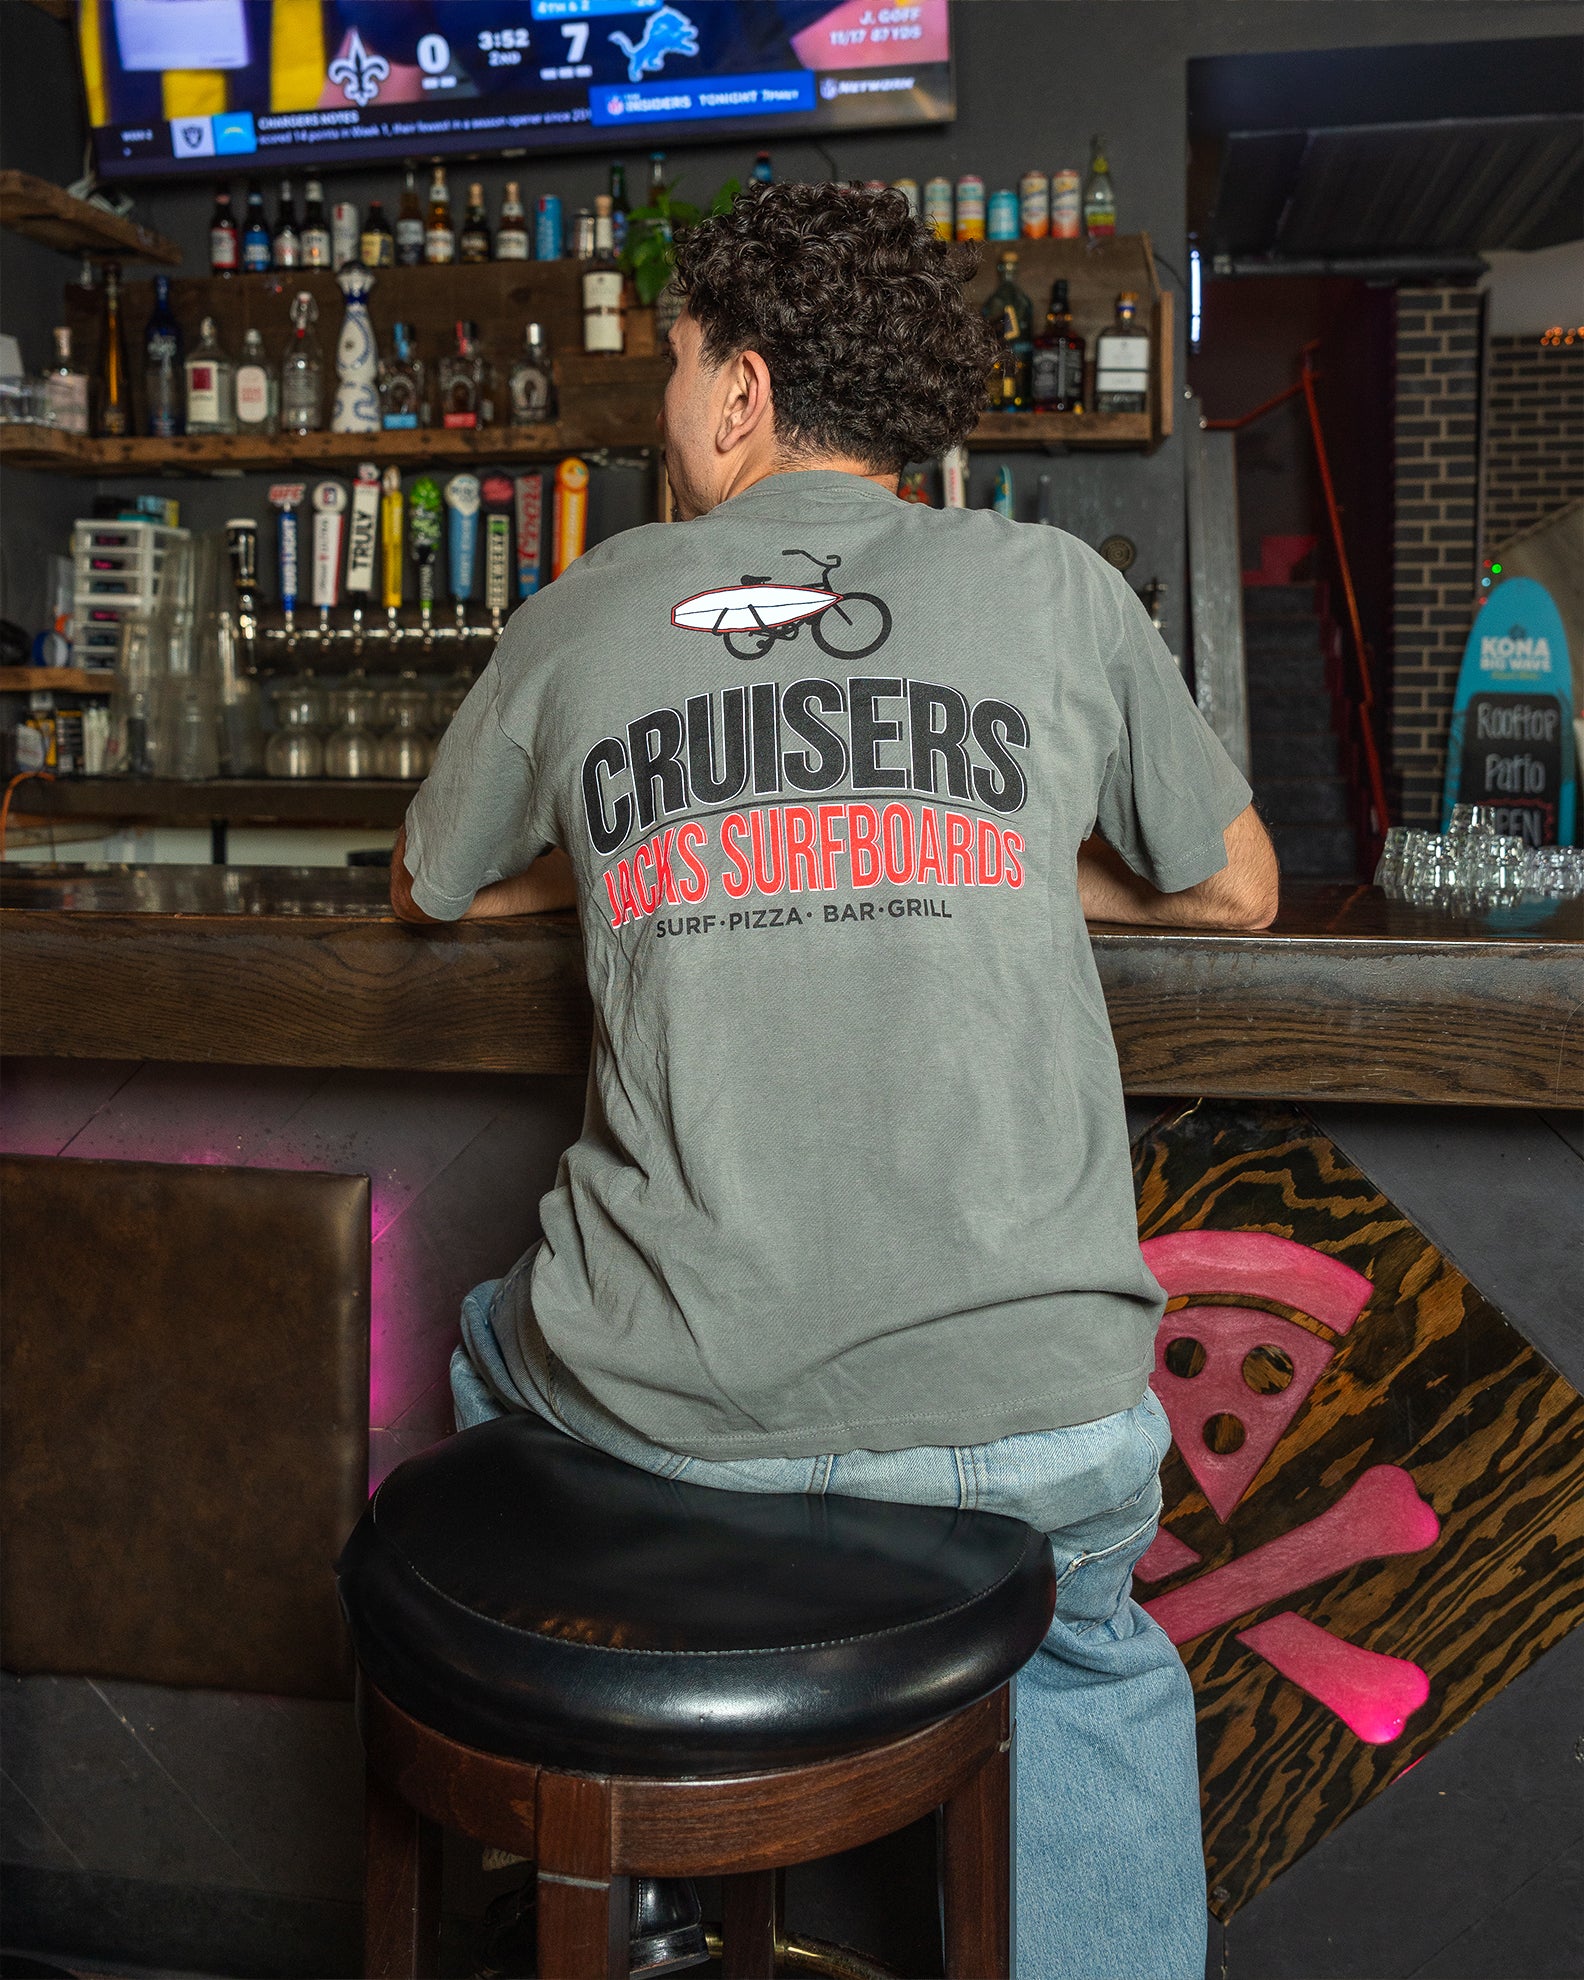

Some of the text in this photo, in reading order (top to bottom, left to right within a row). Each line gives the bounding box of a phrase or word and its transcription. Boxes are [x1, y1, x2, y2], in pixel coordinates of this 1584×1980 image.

[877, 6, 921, 23] GOFF
[416, 33, 450, 74] 0
[478, 28, 530, 50] 3:52
[488, 50, 522, 66] 2ND
[561, 22, 589, 63] 7
[625, 95, 692, 112] INSIDERS
[698, 90, 758, 106] TONIGHT
[352, 510, 371, 571] TRULY
[1481, 636, 1550, 657] KONA
[580, 676, 1031, 856] CRUISERS
[1485, 753, 1546, 794] Patio
[1494, 808, 1542, 847] PEN
[602, 802, 1026, 929] JACKS SURFBOARDS
